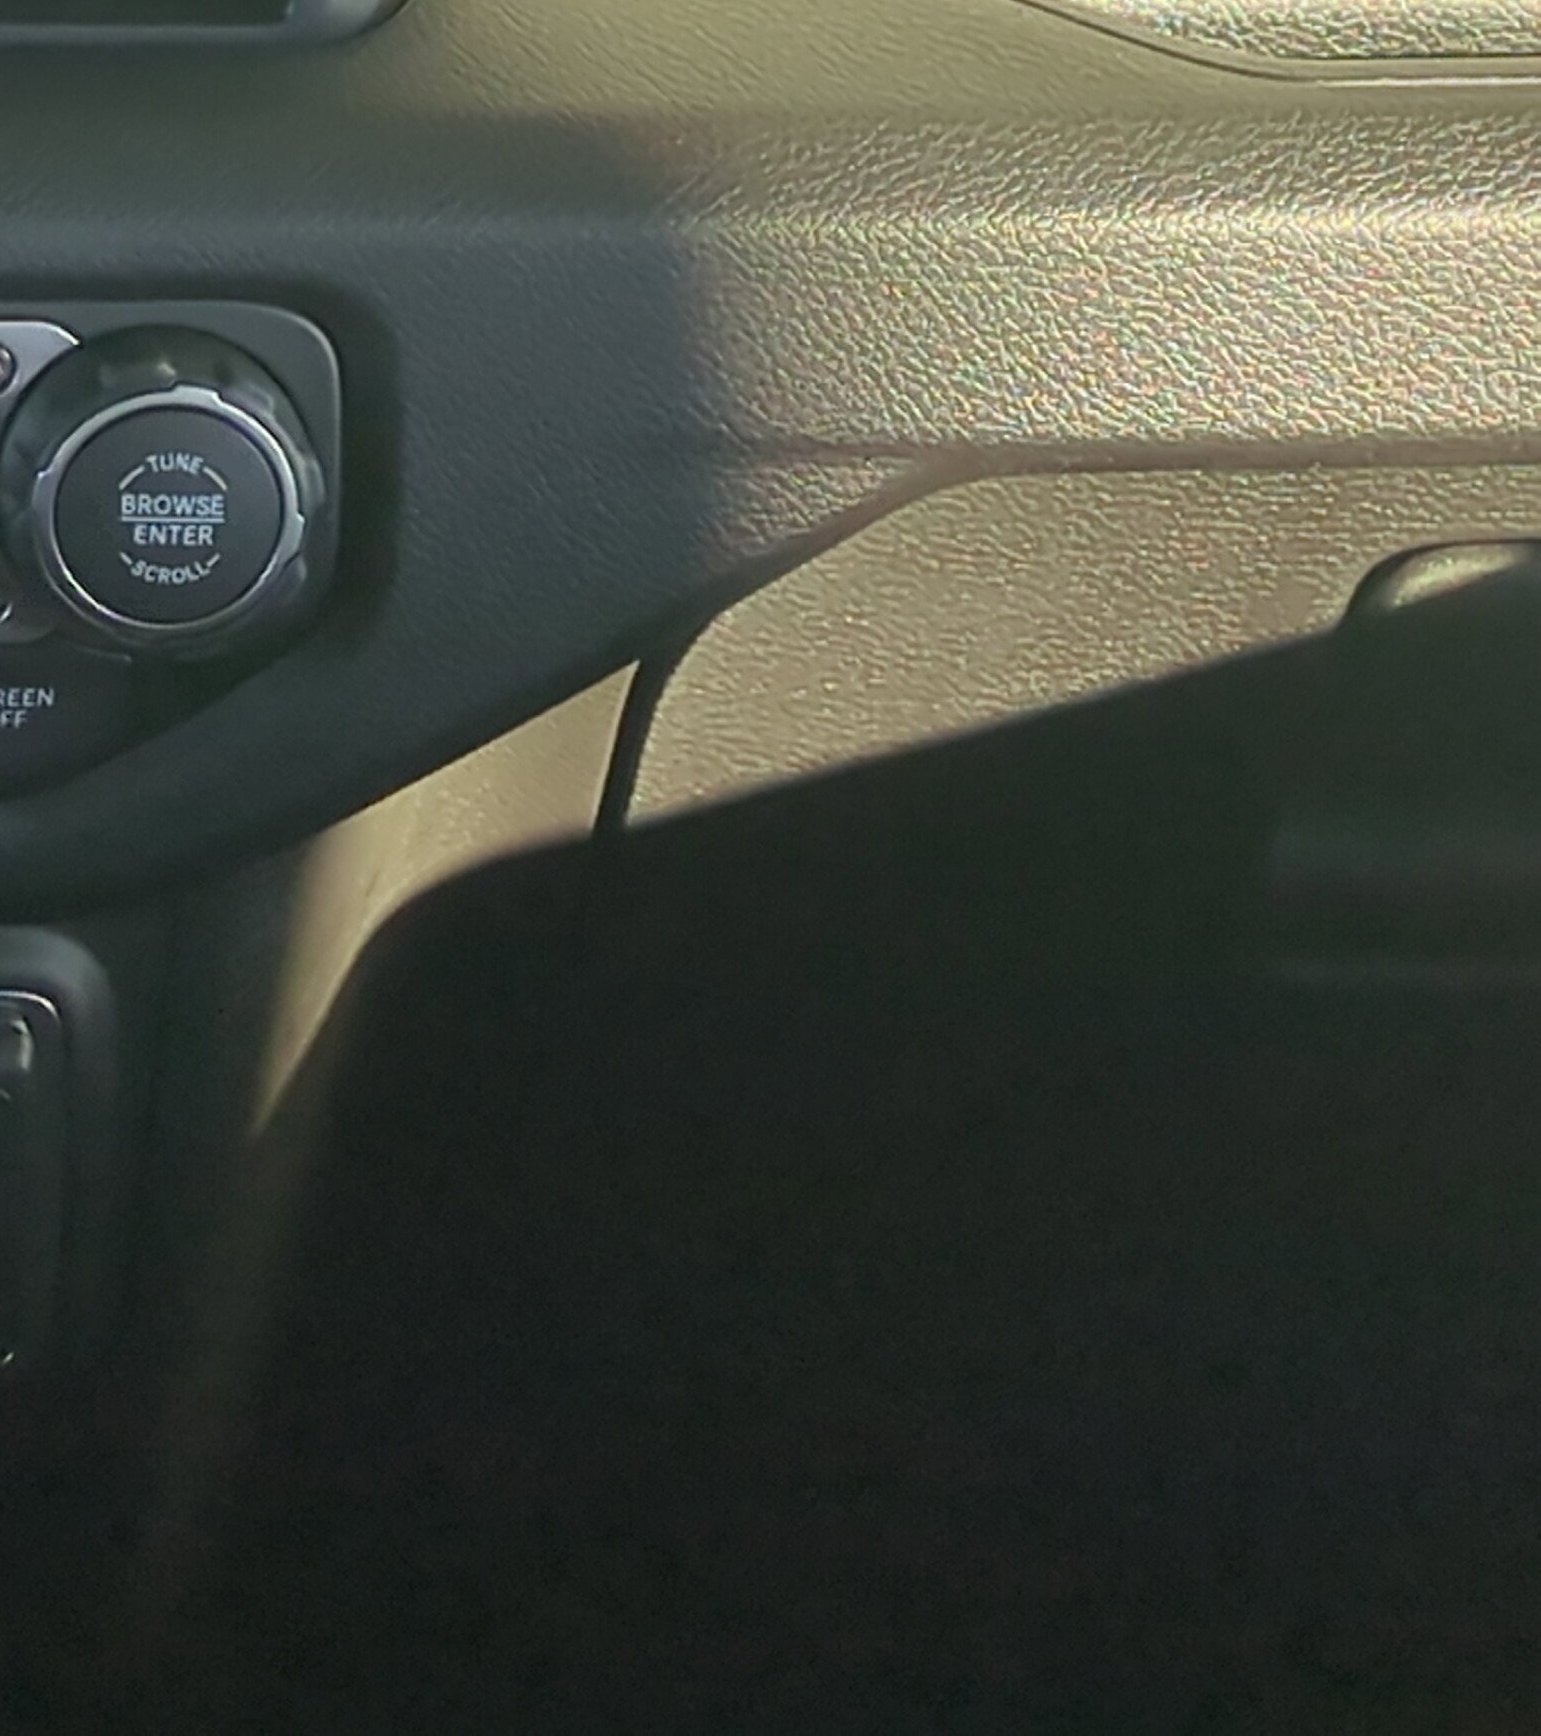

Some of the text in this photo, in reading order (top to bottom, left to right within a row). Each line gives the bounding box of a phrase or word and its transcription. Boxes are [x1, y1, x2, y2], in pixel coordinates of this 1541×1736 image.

[146, 452, 205, 476] TUNE
[120, 493, 226, 518] BROWSE
[131, 523, 215, 548] ENTER
[129, 557, 210, 585] SCROLL
